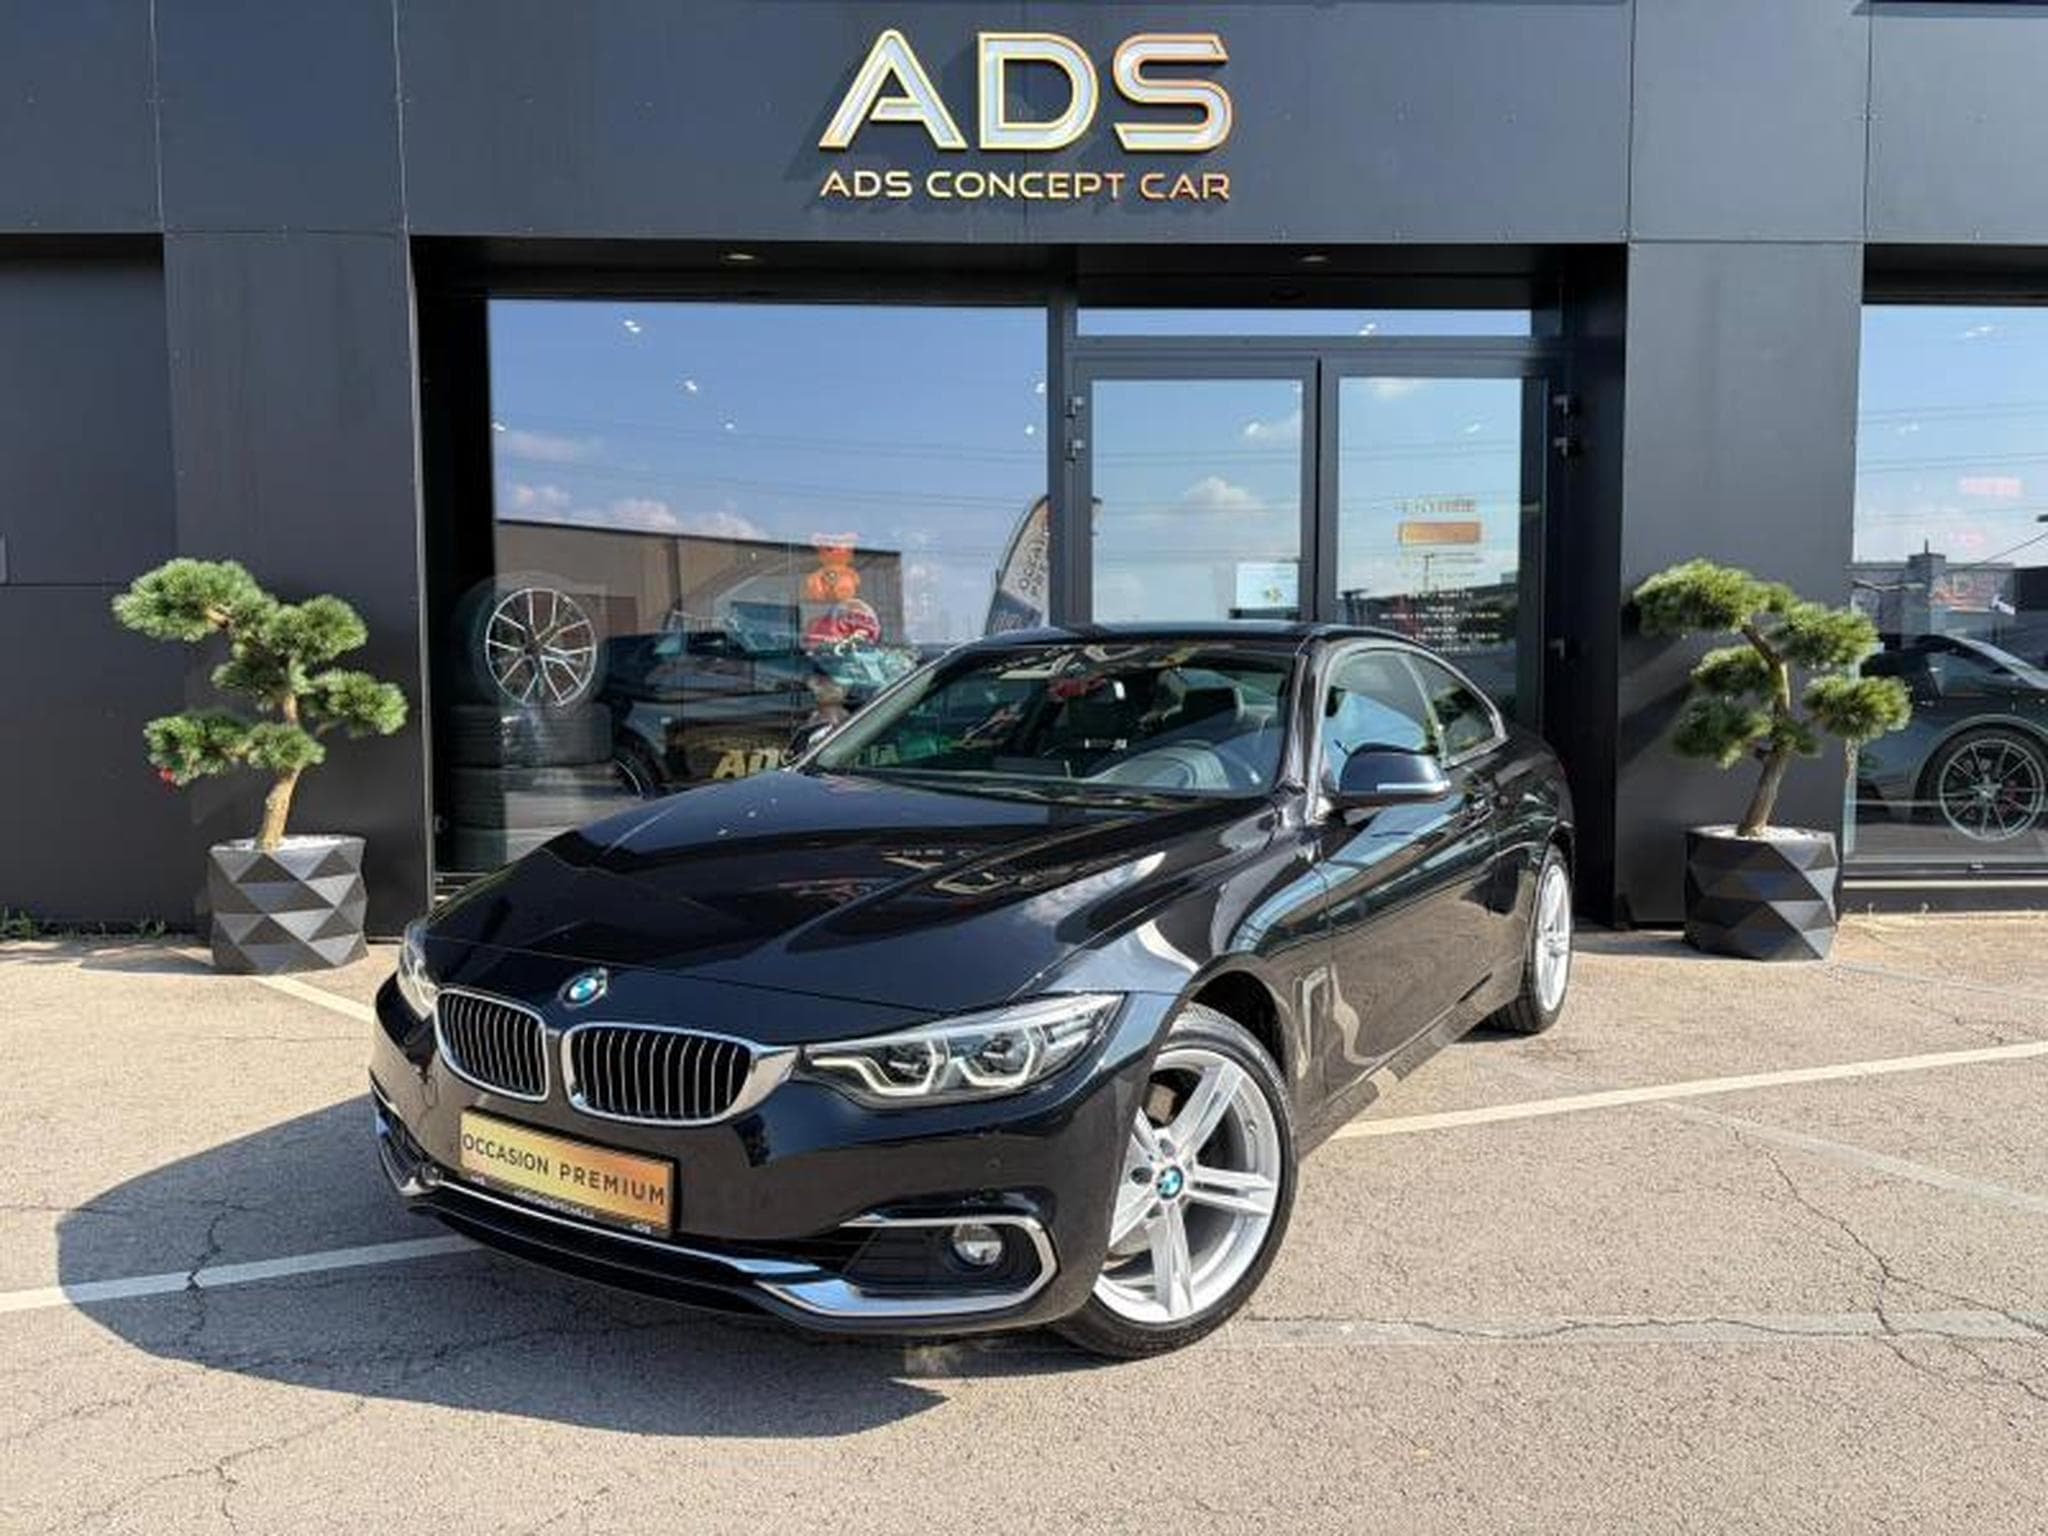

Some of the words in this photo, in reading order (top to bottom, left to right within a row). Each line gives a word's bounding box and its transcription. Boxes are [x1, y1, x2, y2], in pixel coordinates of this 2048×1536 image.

[818, 29, 1233, 151] ADS
[820, 171, 911, 197] ADS
[926, 171, 1124, 198] CONCEPT
[1139, 173, 1230, 200] CAR
[462, 1132, 550, 1176] OCCASION
[559, 1162, 665, 1207] PREMIUM
